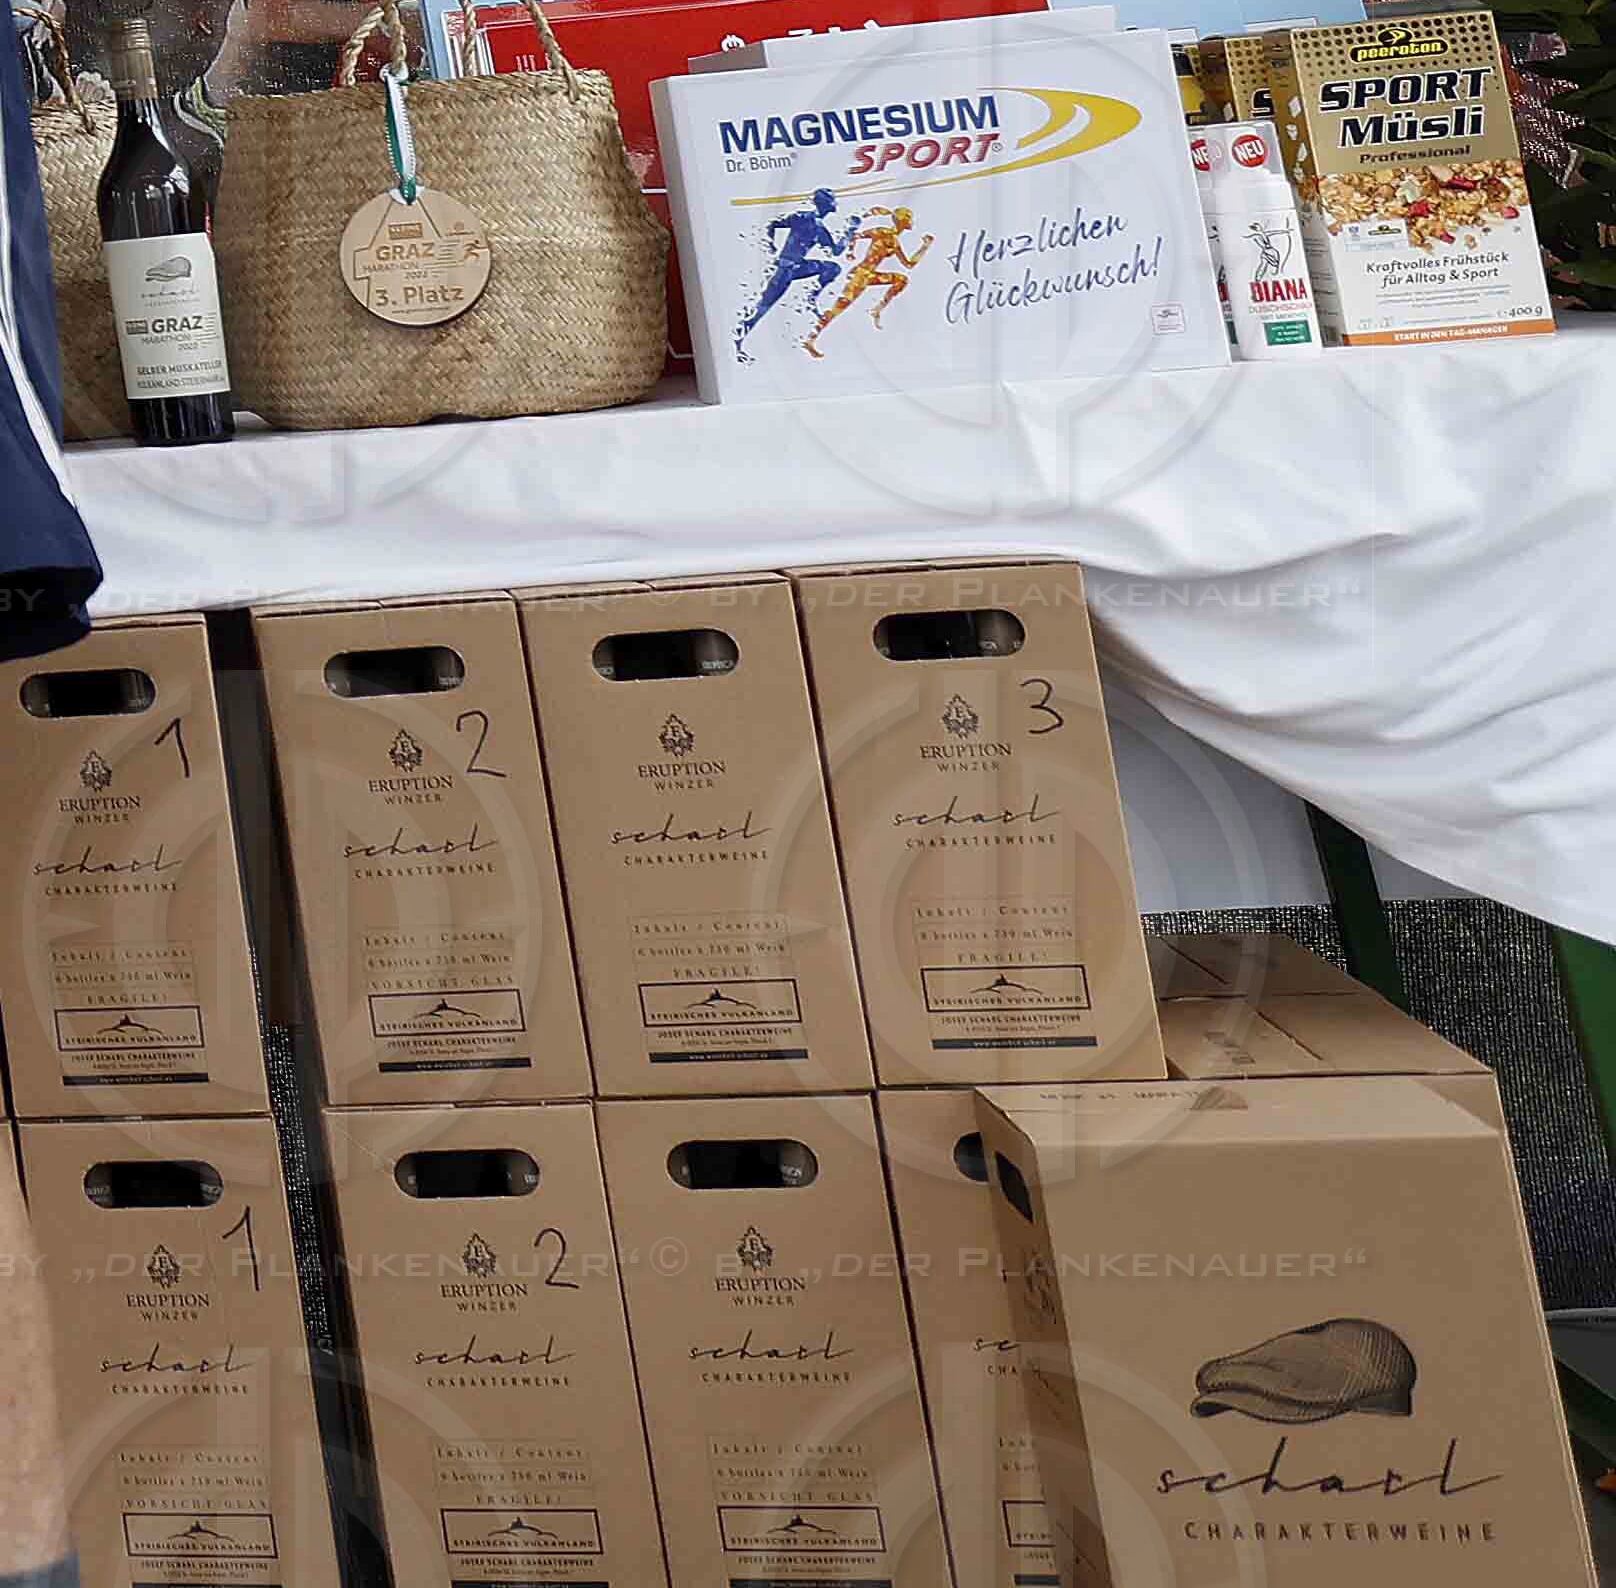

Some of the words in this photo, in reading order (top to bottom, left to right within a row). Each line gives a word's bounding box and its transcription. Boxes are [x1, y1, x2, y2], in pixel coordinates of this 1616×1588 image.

[1355, 40, 1445, 62] peeroton
[1319, 66, 1494, 113] SPORT
[718, 94, 1001, 155] MAGNESIUM
[1336, 104, 1486, 150] Müsli
[1234, 140, 1265, 162] NEU
[1358, 144, 1472, 165] Professional
[725, 156, 747, 174] Dr.
[946, 206, 1129, 274] Herzlichen
[375, 242, 435, 262] GRAZ
[1367, 259, 1441, 274] Kraftvolles
[1442, 252, 1510, 269] Frühstück
[945, 236, 1164, 326] Glückwunsch!
[1381, 274, 1403, 289] für
[1449, 269, 1460, 280] &
[1462, 266, 1500, 282] Sport
[375, 288, 398, 307] 3.
[403, 284, 465, 305] Platz
[1249, 278, 1308, 302] DIANA
[151, 315, 203, 333] GRAZ
[1018, 676, 1065, 736] 3
[154, 716, 191, 779] 1
[455, 709, 507, 778] 2
[919, 742, 1013, 759] ERUPTION
[637, 759, 727, 779] ERUPTION
[368, 775, 454, 794] ERUPTION
[58, 795, 141, 813] ERUPTION
[221, 1204, 260, 1292] 1
[533, 1226, 580, 1290] 2
[440, 1282, 529, 1299] ERUPTION
[714, 1276, 806, 1292] ERUPTION
[126, 1293, 210, 1310] ERUPTION
[1184, 1519, 1498, 1543] CHARAKTERWEINE
